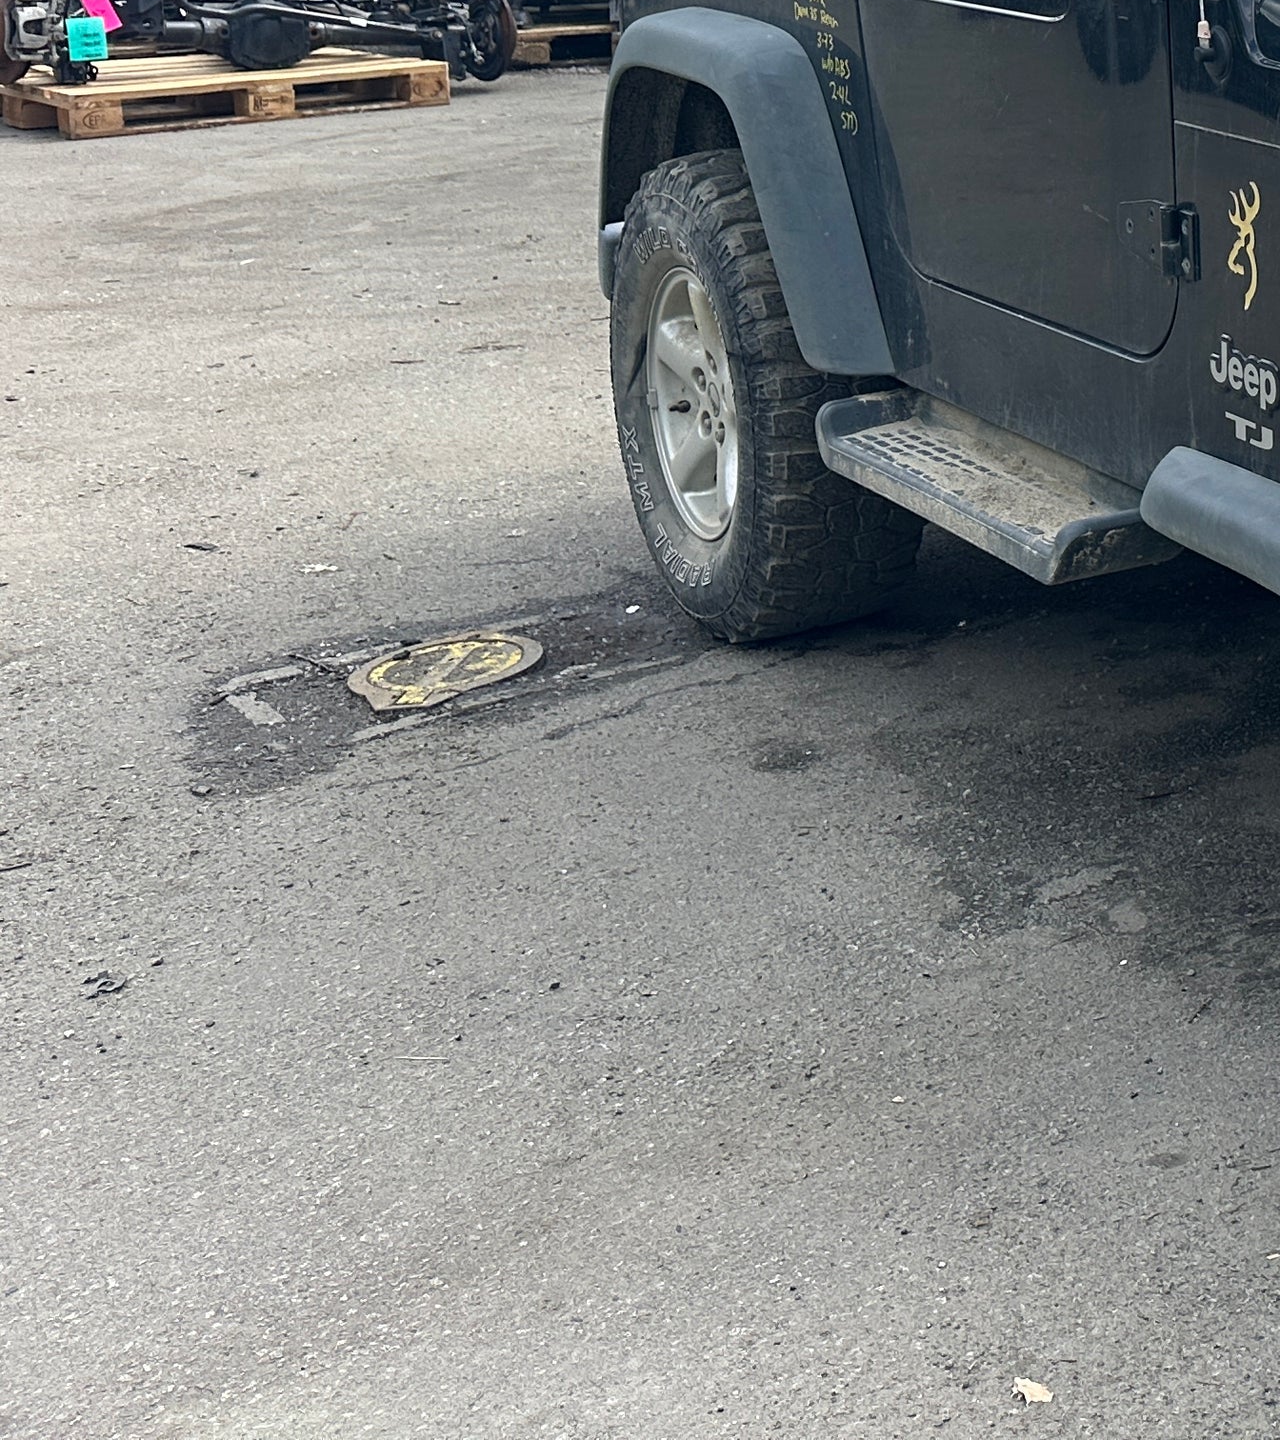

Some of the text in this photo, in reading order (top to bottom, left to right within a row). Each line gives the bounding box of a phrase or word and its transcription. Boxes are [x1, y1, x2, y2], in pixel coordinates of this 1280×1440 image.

[1209, 333, 1280, 410] Jeep
[622, 424, 654, 512] MTX
[1225, 411, 1274, 450] TJ
